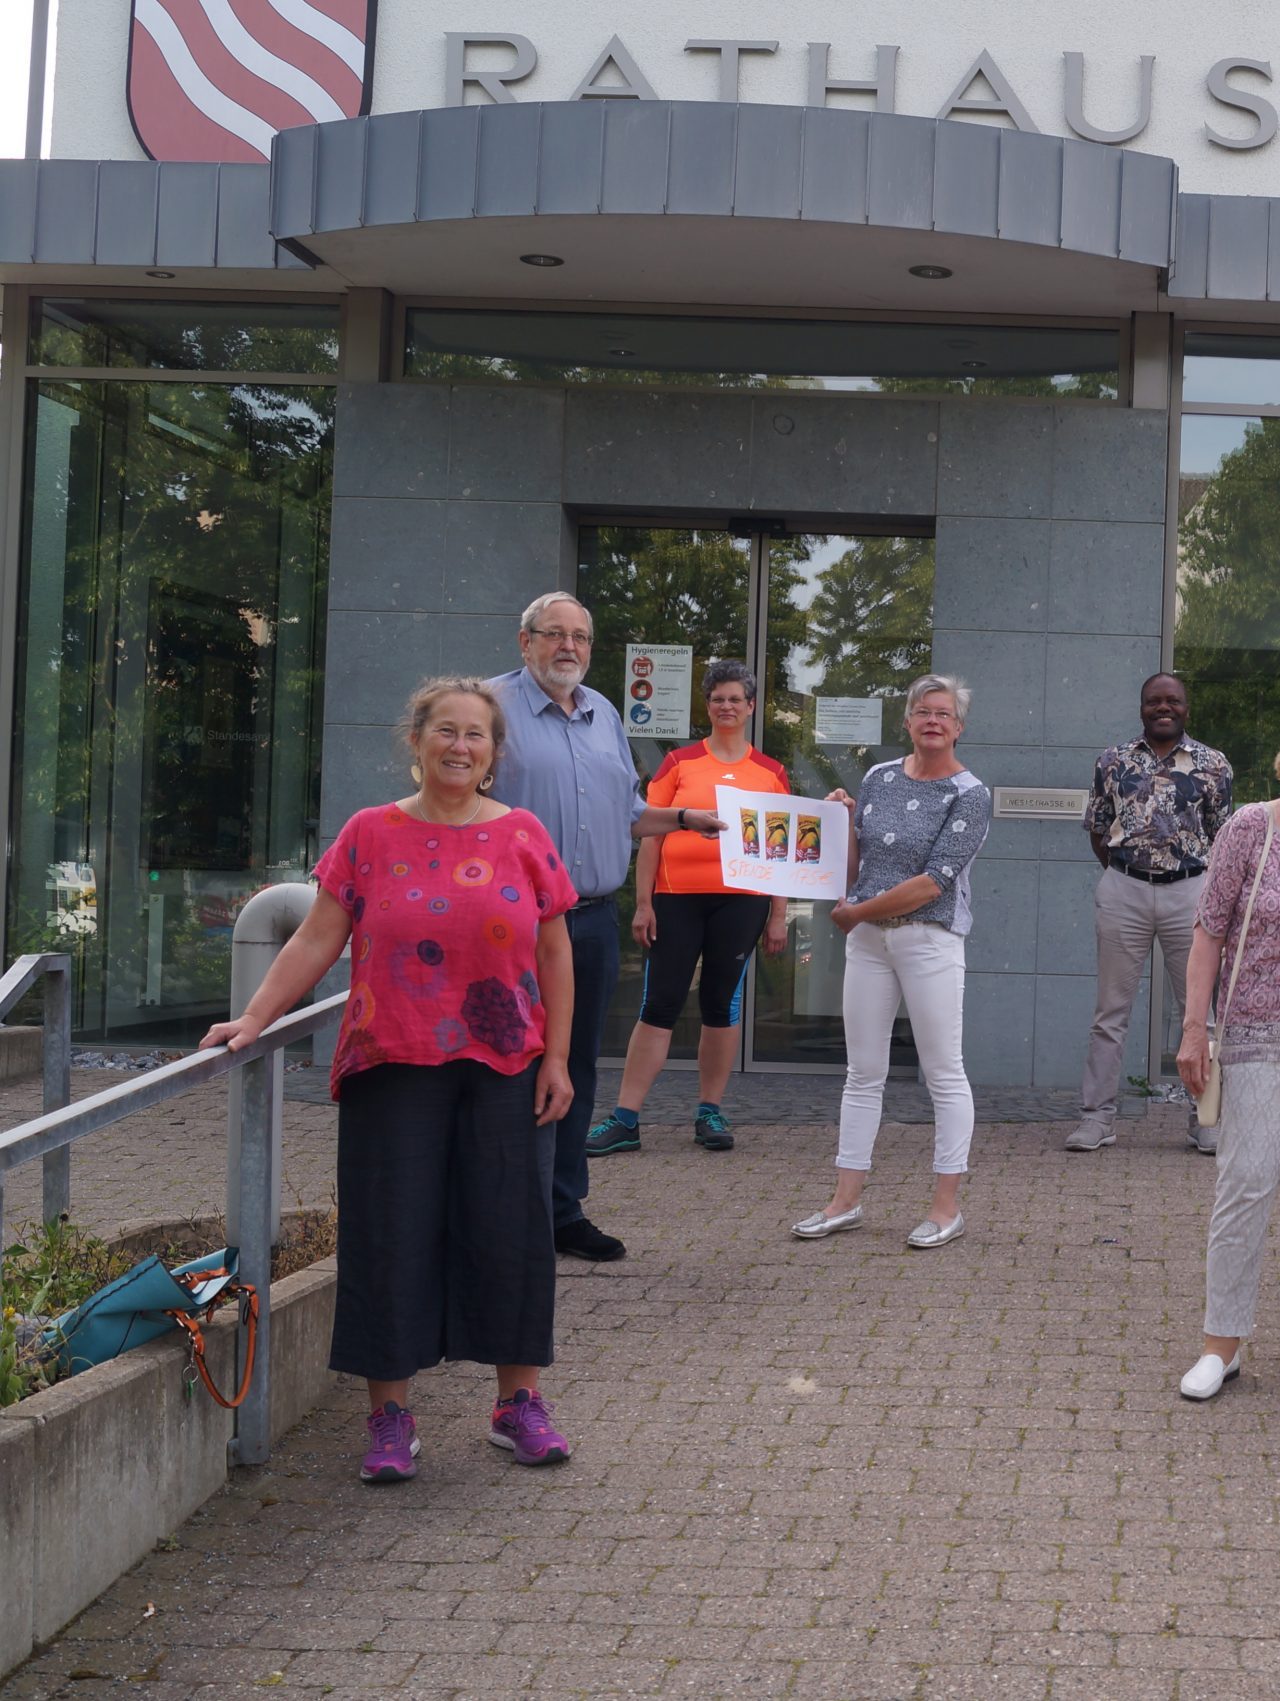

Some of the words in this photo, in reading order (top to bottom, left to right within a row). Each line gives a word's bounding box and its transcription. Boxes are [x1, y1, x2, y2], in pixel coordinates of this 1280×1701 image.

[444, 31, 1280, 152] RATHAUS
[631, 646, 689, 656] Hygieneregeln
[629, 726, 653, 734] Vielen
[655, 727, 678, 735] Dank!
[728, 859, 774, 880] SPENDE
